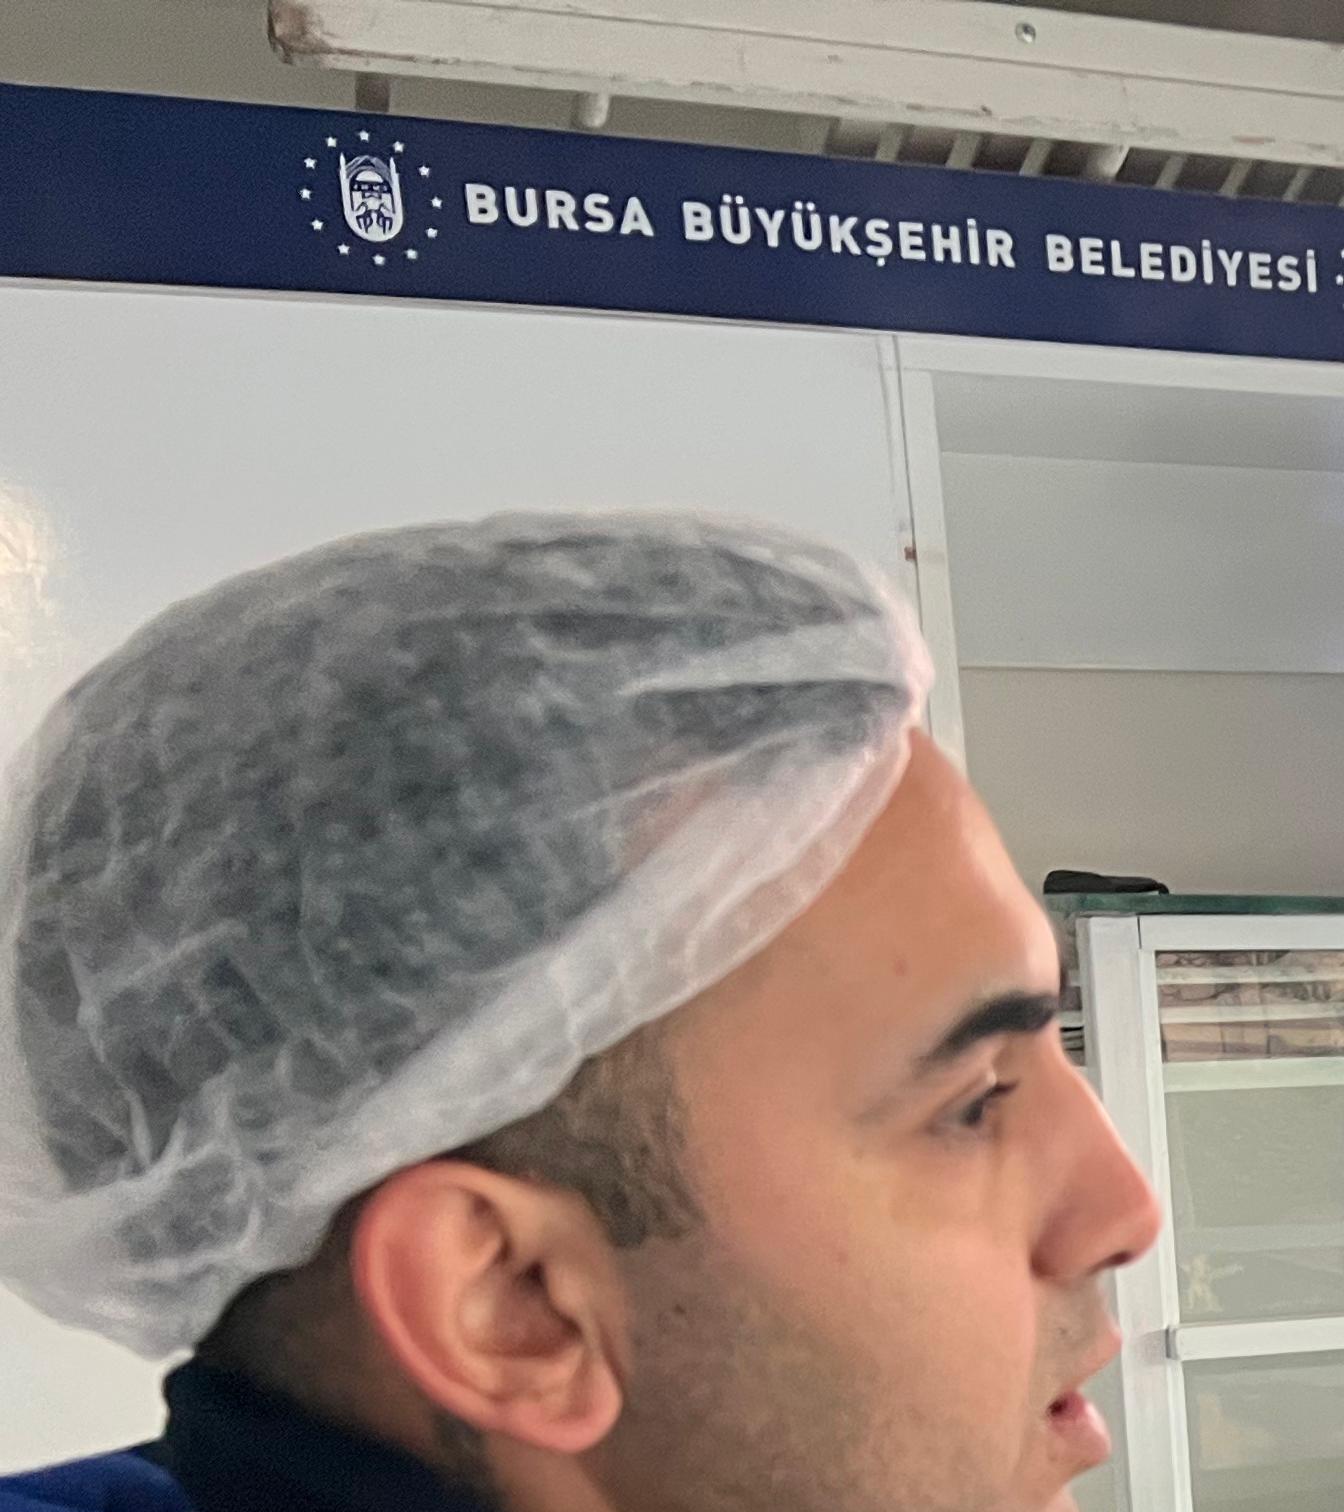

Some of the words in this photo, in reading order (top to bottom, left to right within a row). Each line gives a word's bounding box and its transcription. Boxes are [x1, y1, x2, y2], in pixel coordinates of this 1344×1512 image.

[464, 183, 655, 238] BURSA
[683, 194, 1016, 269] BÜYÜKŞEHİR
[1046, 234, 1318, 293] BELEDİYESİ
